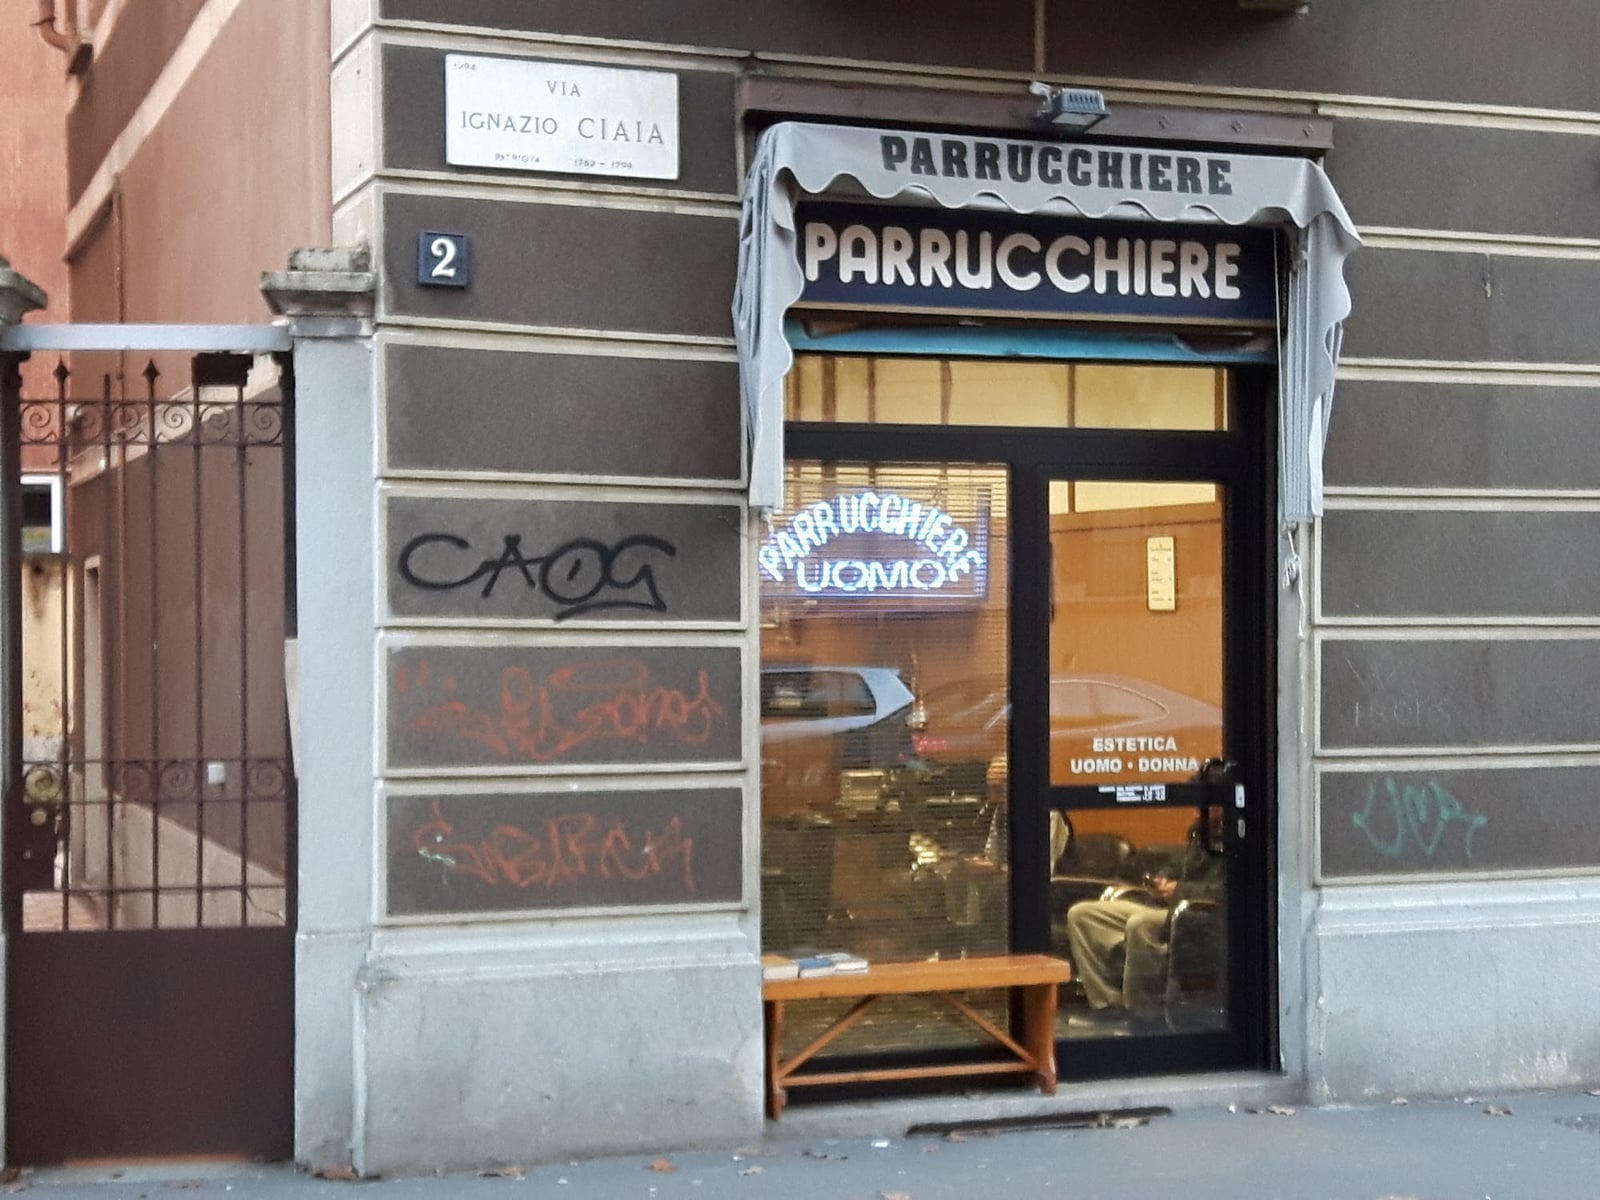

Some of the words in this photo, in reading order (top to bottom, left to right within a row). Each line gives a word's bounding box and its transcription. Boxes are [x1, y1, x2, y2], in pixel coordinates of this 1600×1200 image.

[546, 80, 581, 97] VIA
[461, 111, 558, 134] IGNAZIO
[577, 118, 665, 145] CIAIA
[879, 134, 1233, 196] PARRUCCHIERE
[431, 238, 456, 278] 2
[803, 221, 1242, 299] PARRUCCHIERE
[797, 560, 945, 592] UOMO
[1092, 736, 1177, 752] ESTETICA
[1070, 757, 1122, 774] UOMO
[1138, 756, 1199, 773] DONNA
